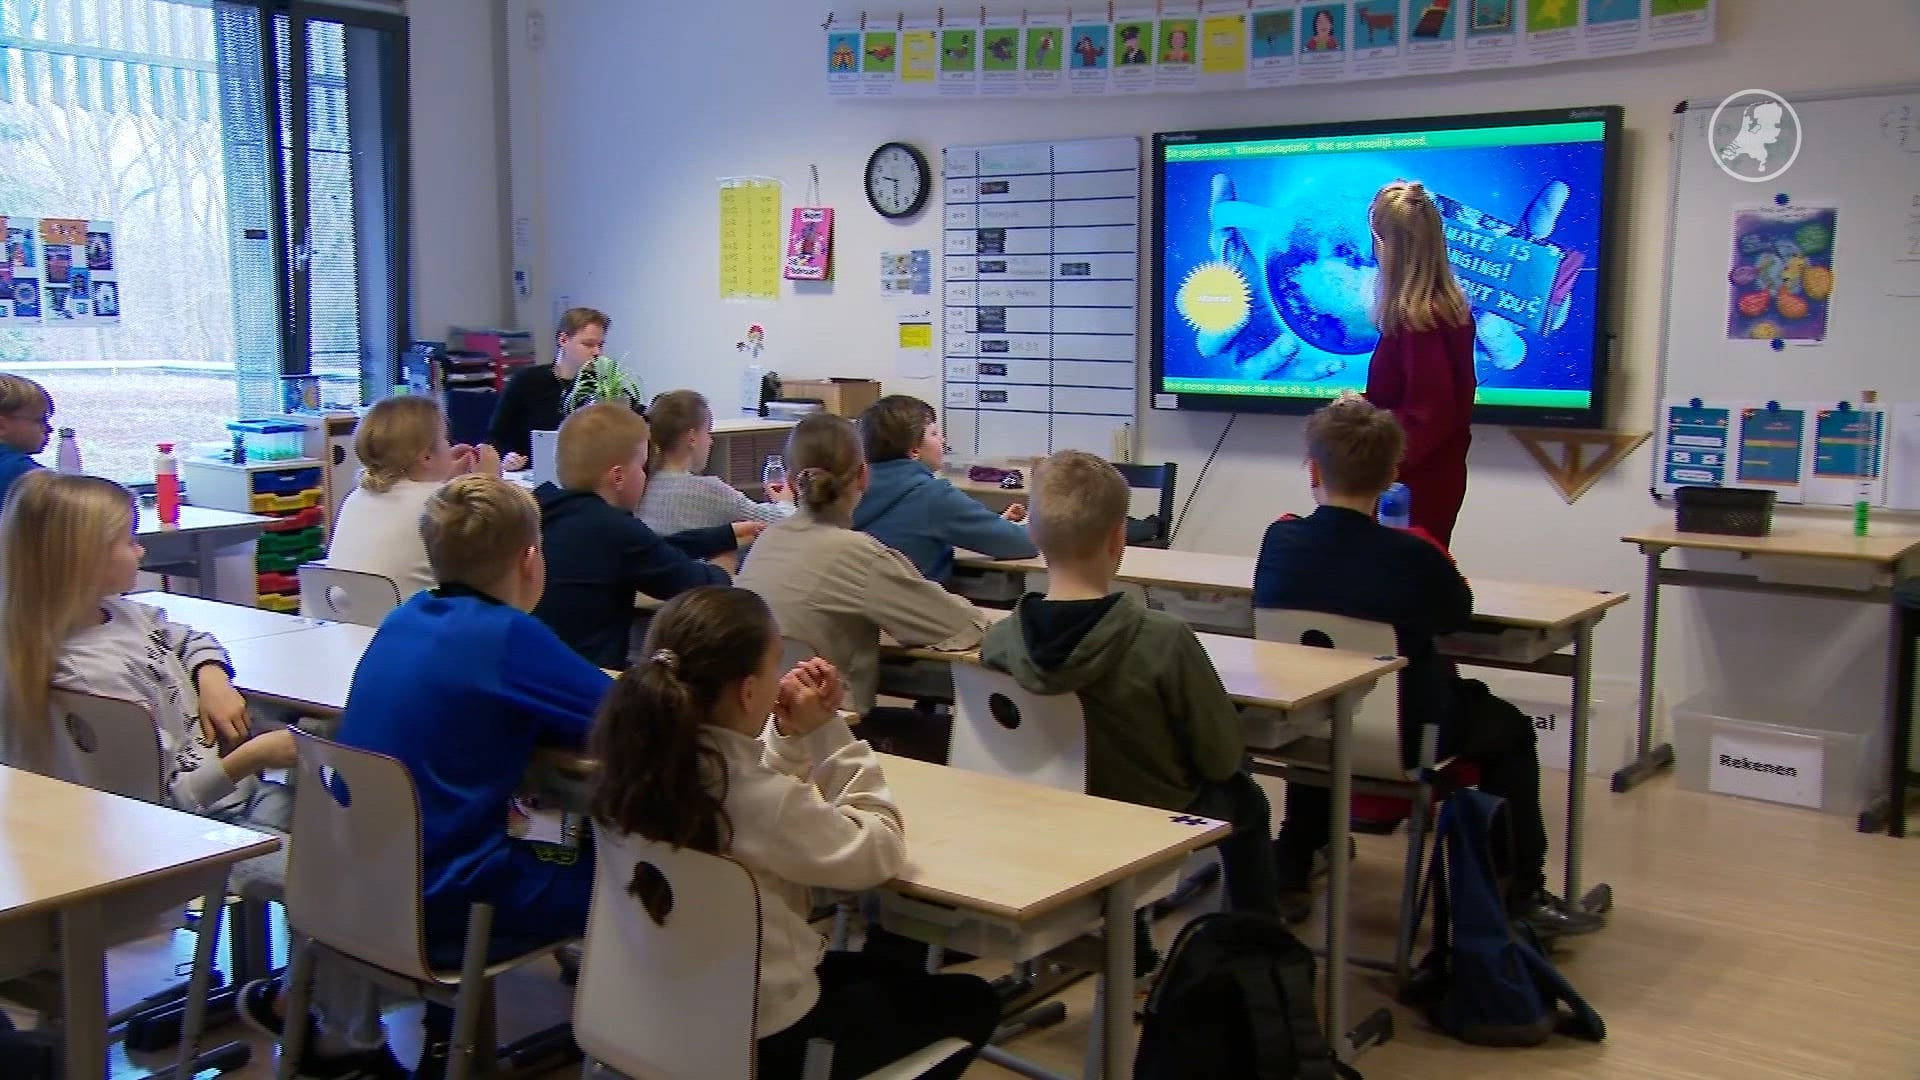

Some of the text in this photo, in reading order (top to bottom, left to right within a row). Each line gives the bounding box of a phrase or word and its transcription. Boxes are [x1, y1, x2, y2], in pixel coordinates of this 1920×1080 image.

[1447, 226, 1532, 261] MATE IS
[1450, 248, 1513, 282] NGING!
[1498, 290, 1542, 318] YOU?
[1718, 752, 1798, 779] Rekenen
